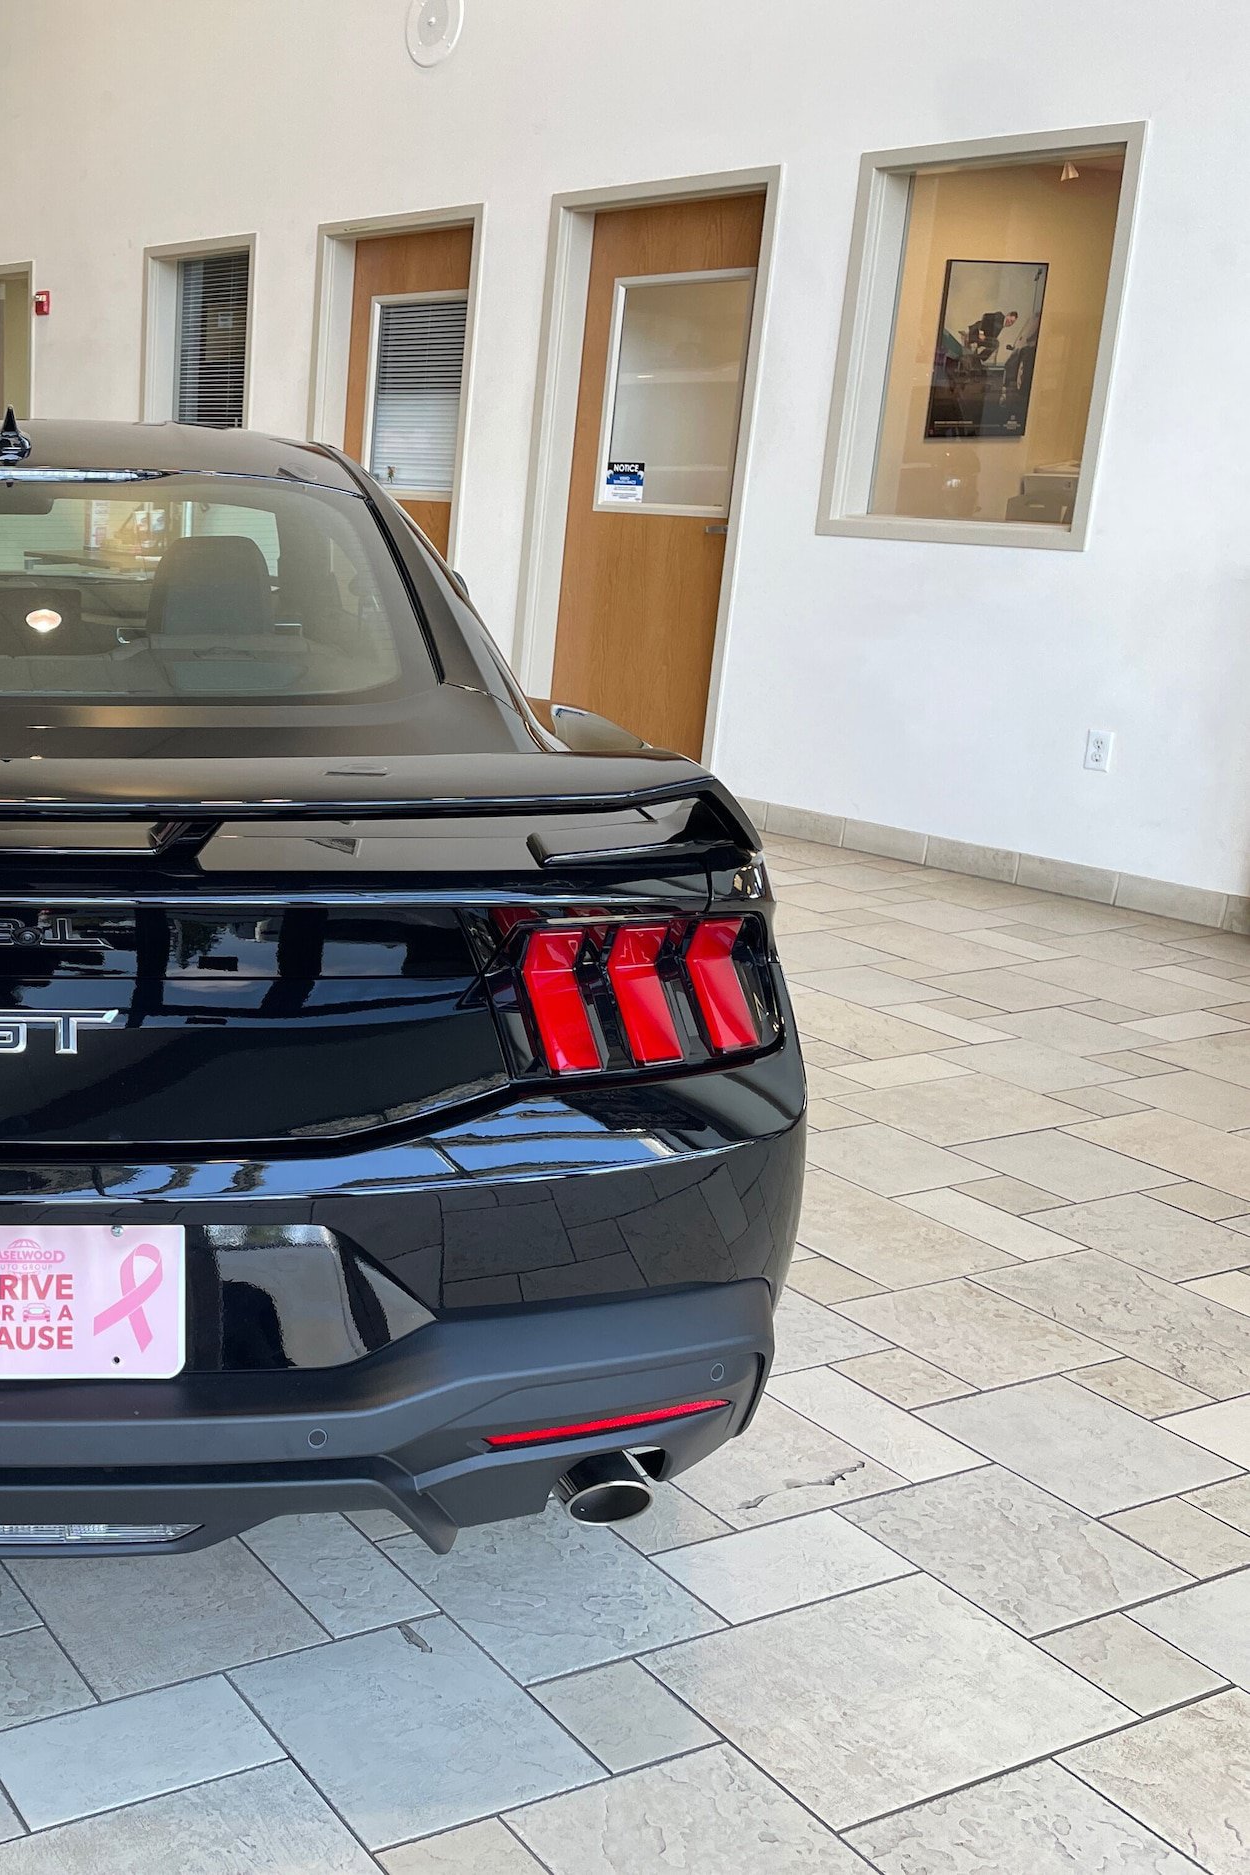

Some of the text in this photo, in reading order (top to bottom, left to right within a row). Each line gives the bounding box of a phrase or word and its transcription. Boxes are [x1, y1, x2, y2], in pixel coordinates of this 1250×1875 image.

[613, 463, 640, 473] NOTICE
[22, 1263, 53, 1271] GROUP
[57, 1304, 74, 1321] A
